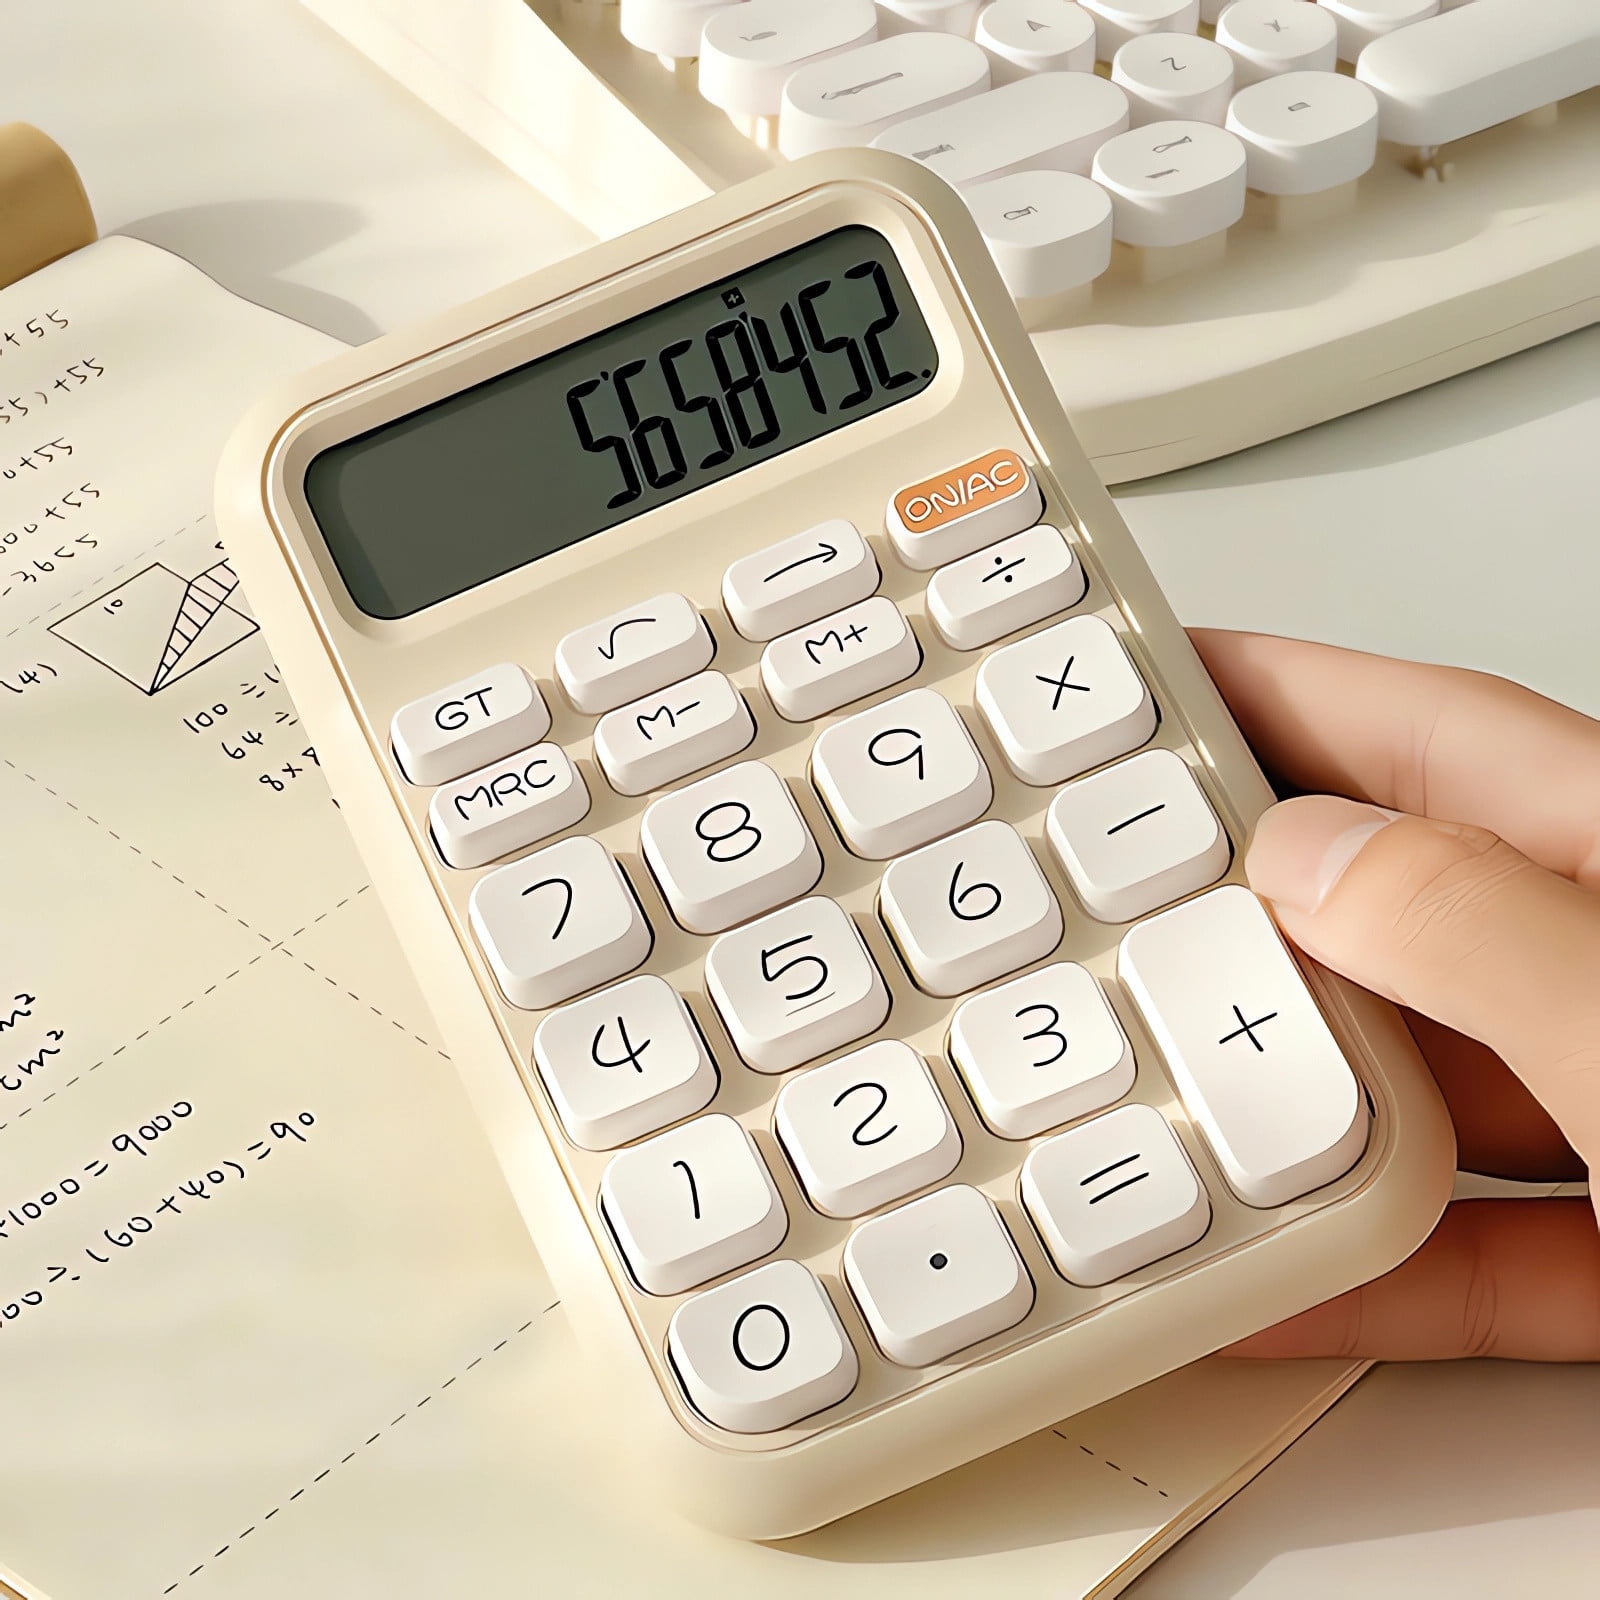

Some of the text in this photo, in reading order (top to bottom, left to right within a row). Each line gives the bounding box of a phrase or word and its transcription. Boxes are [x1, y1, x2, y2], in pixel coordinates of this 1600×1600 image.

[904, 460, 1020, 522] ON/AC
[805, 624, 868, 664] M+
[435, 687, 492, 730] GT
[868, 729, 924, 780] 9
[454, 760, 556, 820] MRC
[695, 802, 761, 862] 8
[522, 878, 572, 940] 7
[949, 862, 1001, 921] 6
[761, 935, 828, 1000] 5
[592, 1016, 650, 1073] 4
[1015, 1004, 1067, 1067] 3
[833, 1083, 898, 1146] 2
[673, 1161, 700, 1219] 1
[733, 1304, 790, 1371] 0
